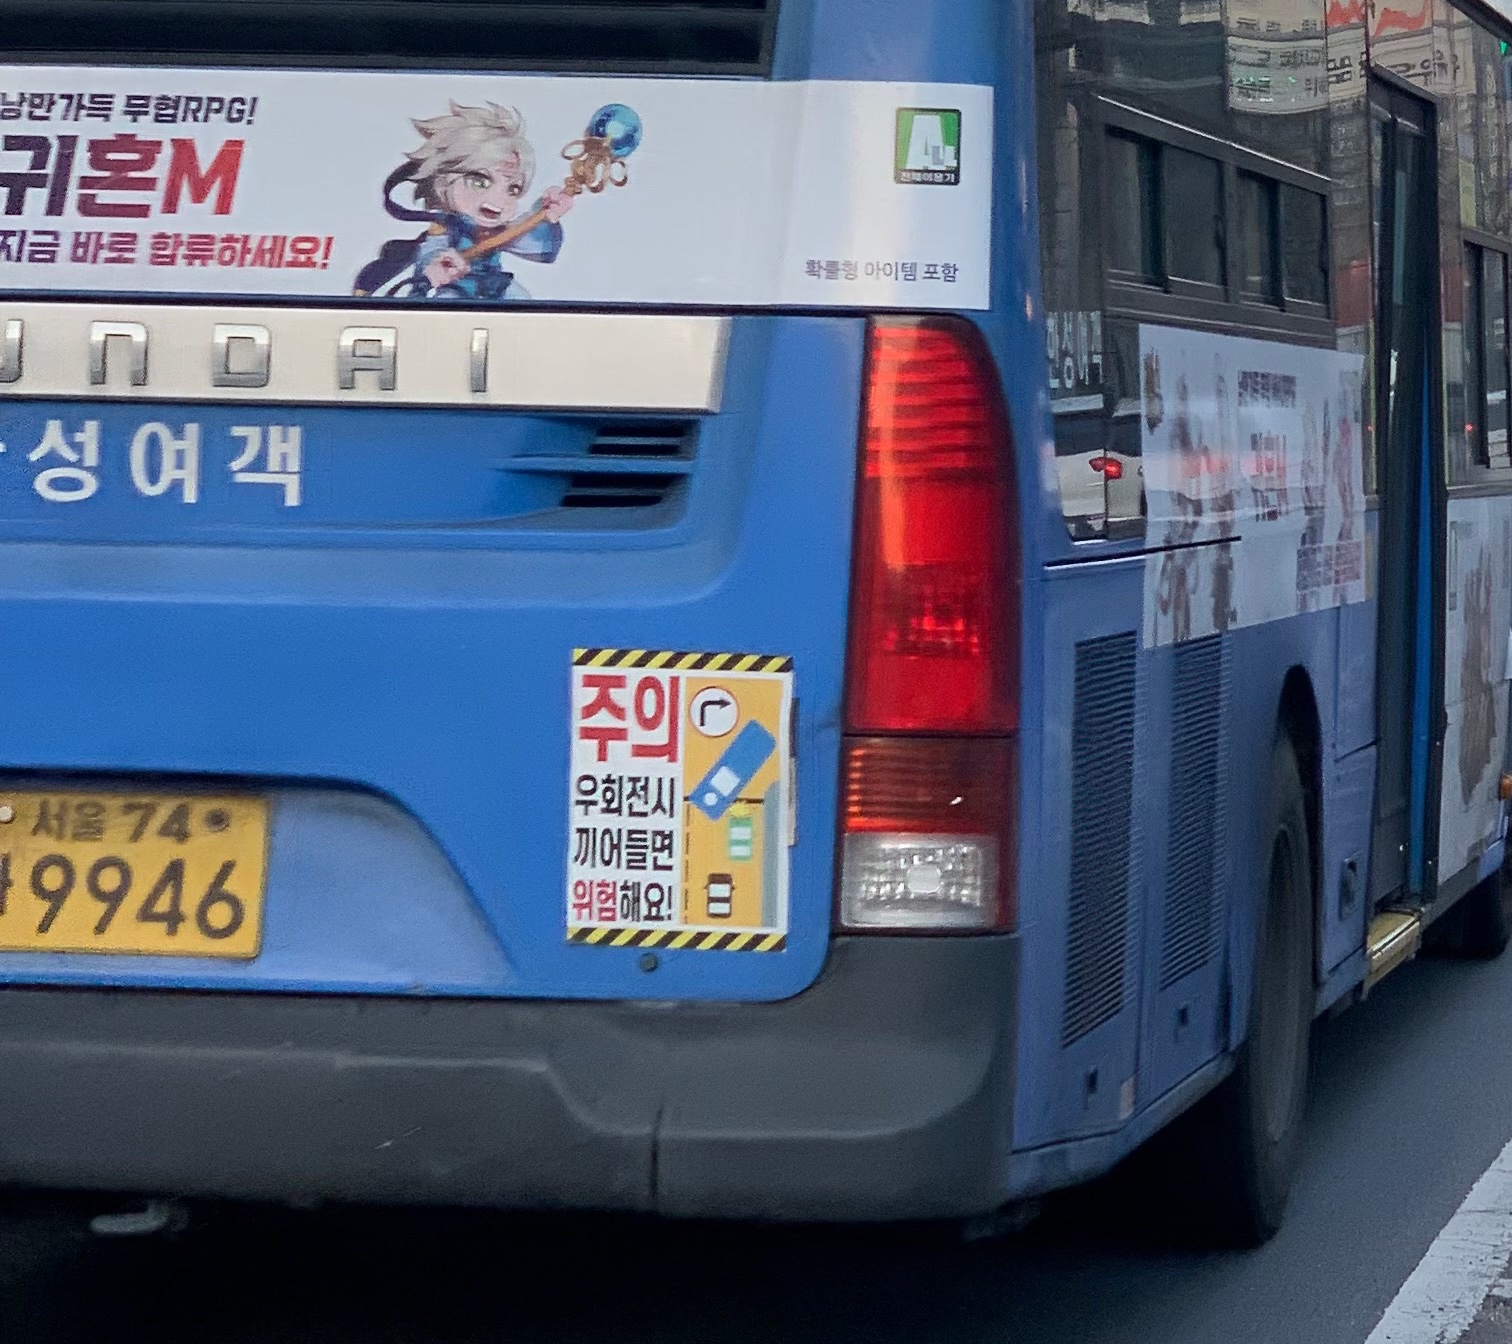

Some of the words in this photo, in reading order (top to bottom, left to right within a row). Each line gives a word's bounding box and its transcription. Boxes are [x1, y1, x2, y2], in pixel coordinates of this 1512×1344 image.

[124, 94, 259, 126] 무협RPG!
[0, 133, 245, 219] 귀혼M
[0, 230, 61, 264] 지금
[70, 231, 138, 266] 바로
[149, 231, 335, 270] 합류하세요!
[805, 259, 859, 281] 확률형
[865, 260, 918, 282] 아이템
[922, 262, 960, 283] 포함
[579, 674, 680, 763] 주의
[575, 773, 675, 819] 우회전시
[31, 798, 107, 843] 서울
[123, 801, 191, 845] 74
[573, 826, 674, 872] 끼어들면
[571, 878, 674, 923] 위험해요!
